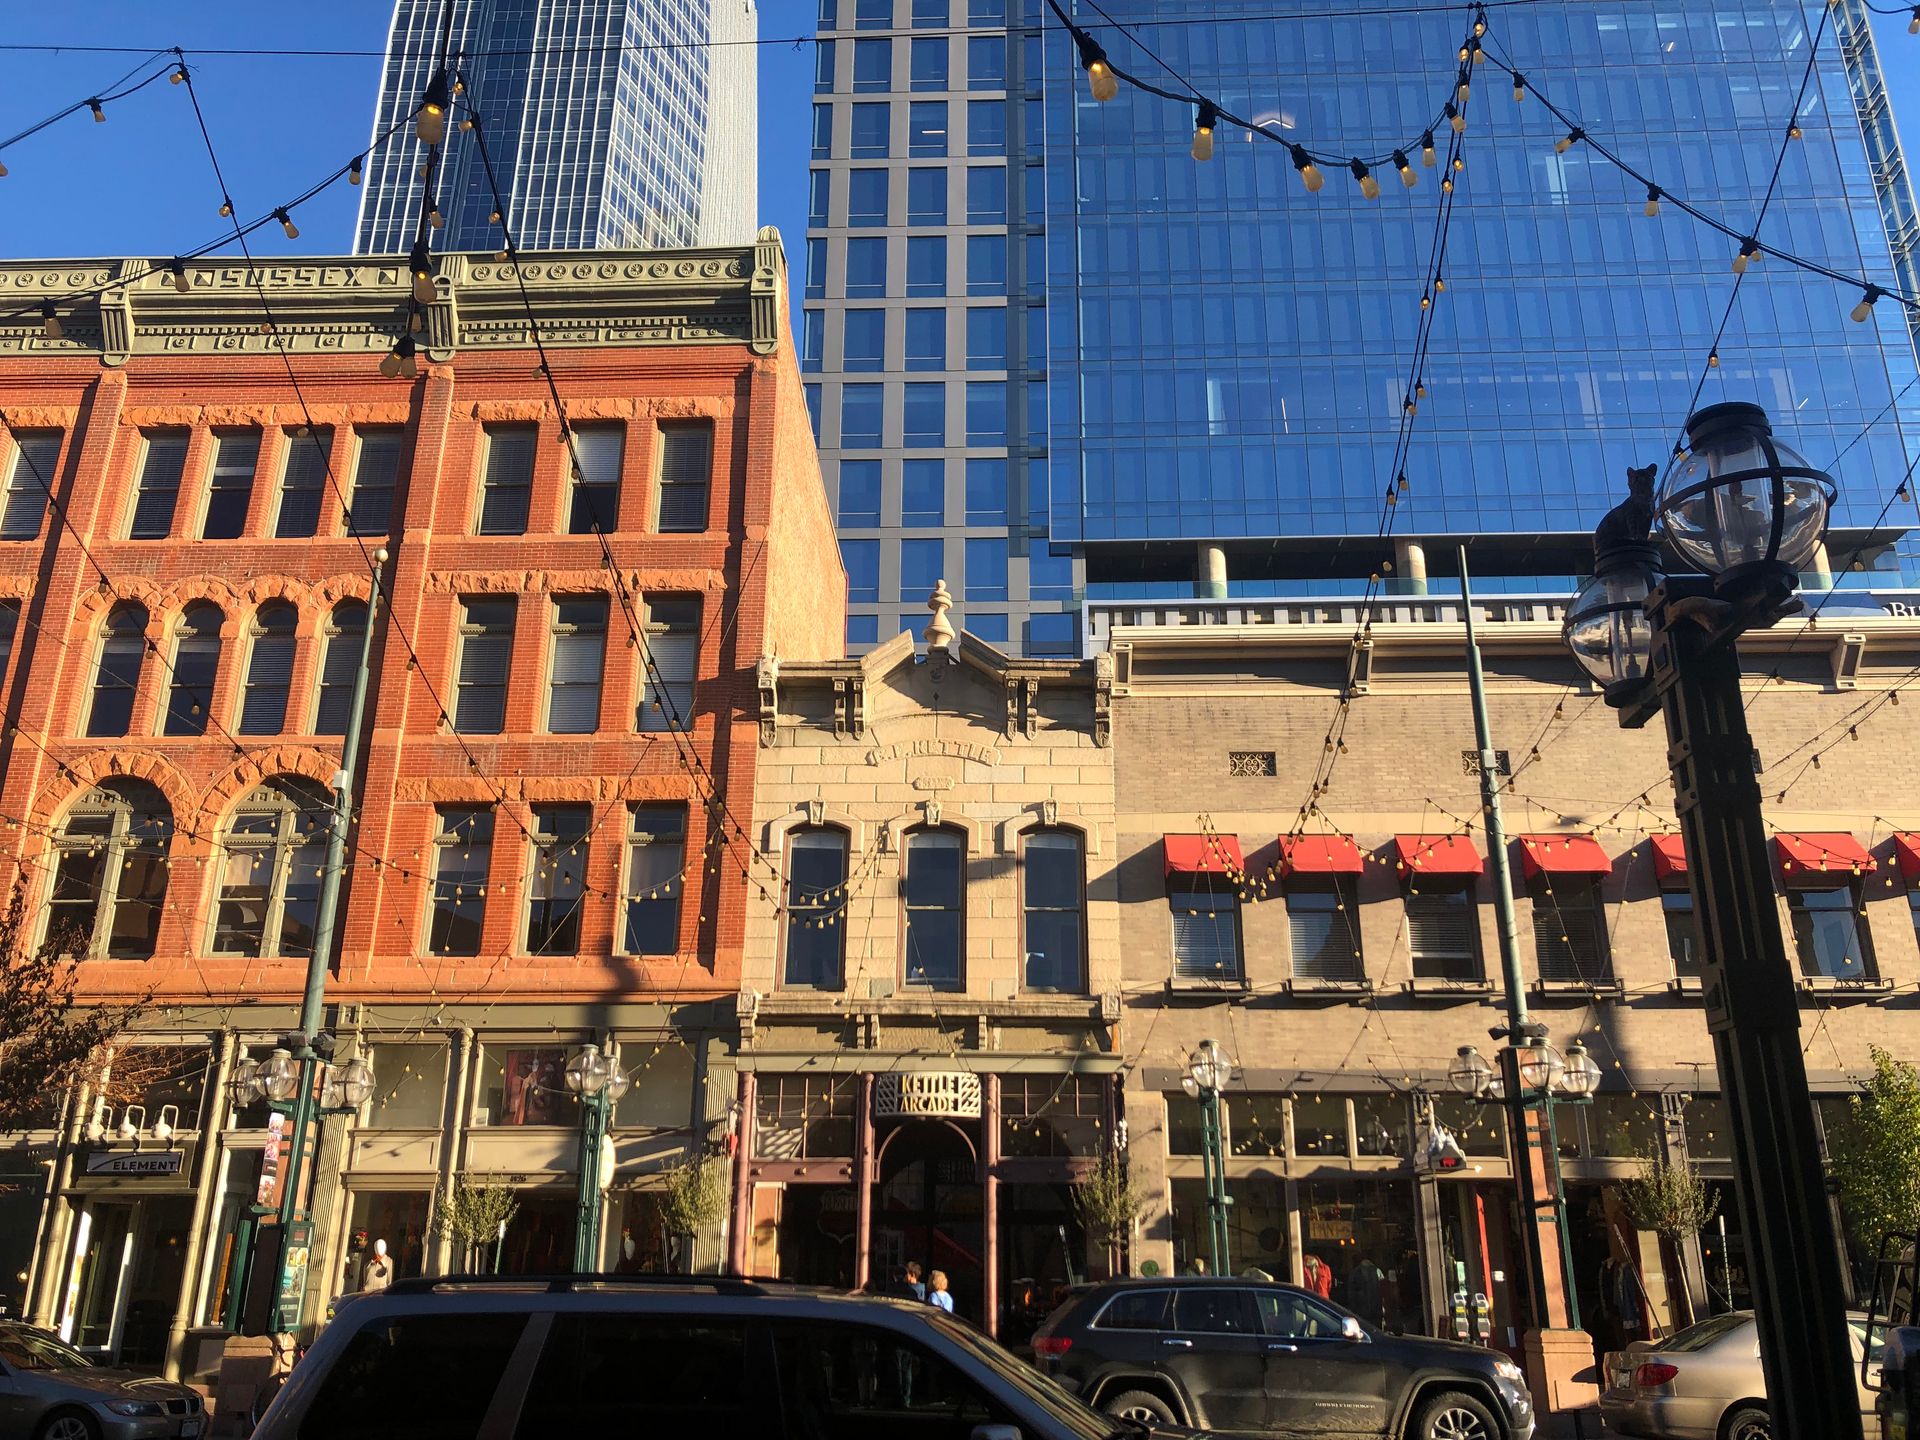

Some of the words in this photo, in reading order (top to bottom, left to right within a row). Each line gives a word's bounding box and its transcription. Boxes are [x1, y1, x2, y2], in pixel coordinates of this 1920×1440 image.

[220, 267, 365, 288] SUSSEX
[912, 739, 992, 764] KETTLE
[901, 1075, 959, 1094] KETTLE
[900, 1095, 959, 1112] ARCADE
[113, 1161, 176, 1170] ELEMENT
